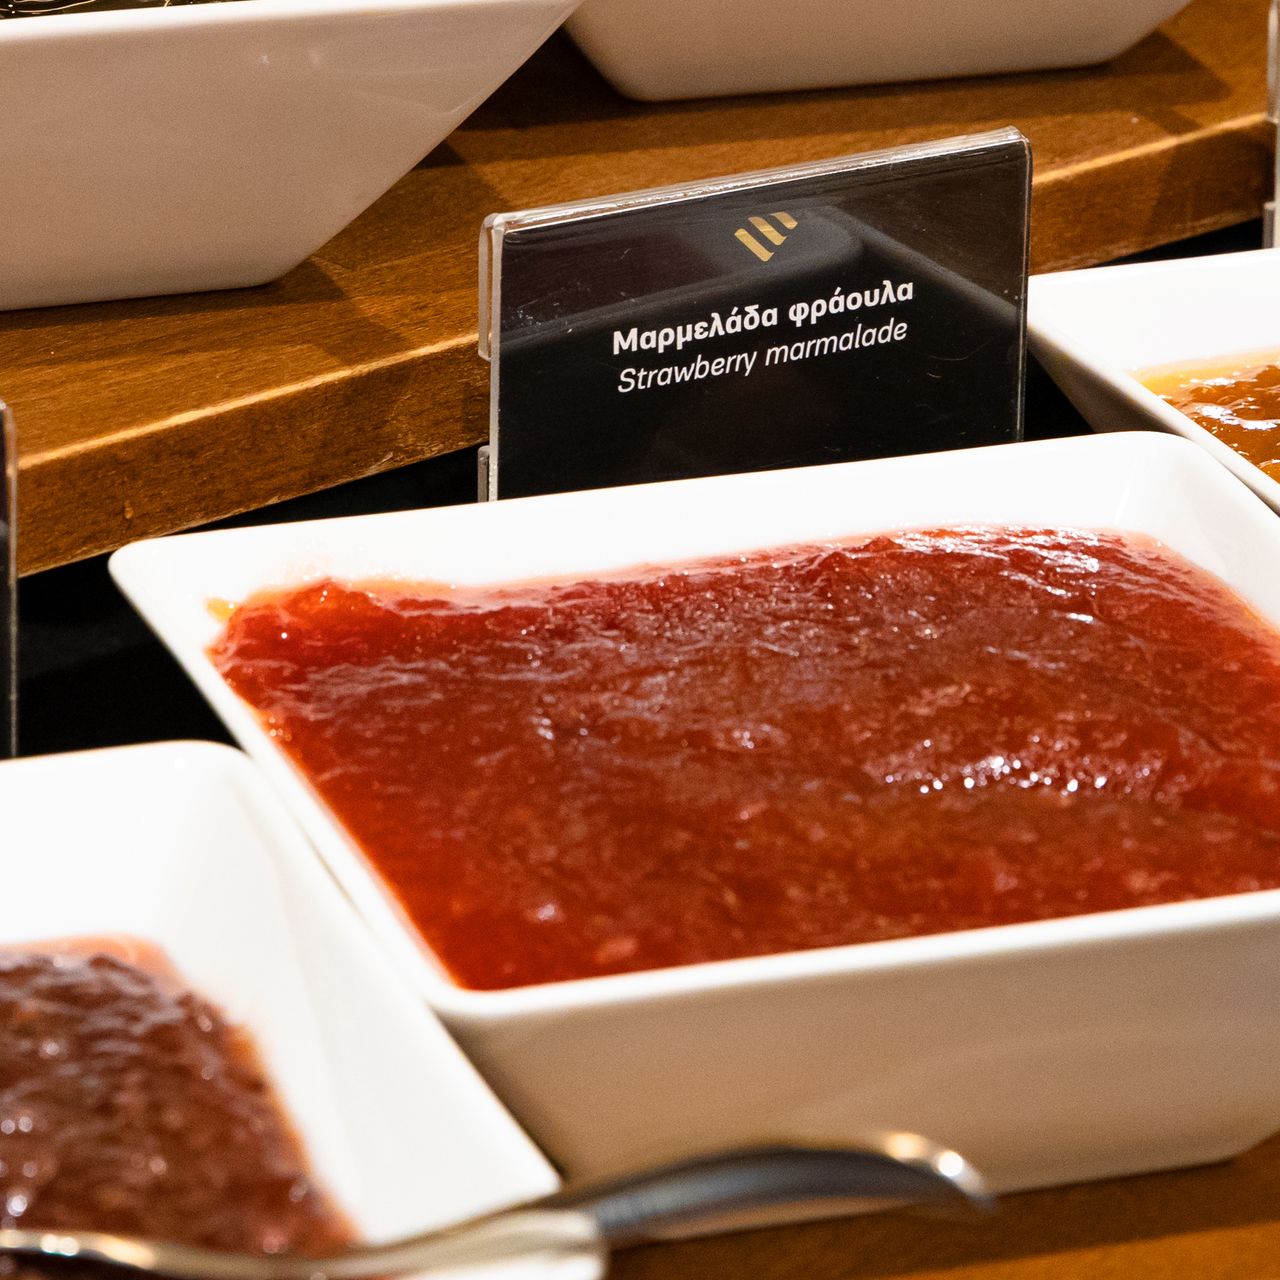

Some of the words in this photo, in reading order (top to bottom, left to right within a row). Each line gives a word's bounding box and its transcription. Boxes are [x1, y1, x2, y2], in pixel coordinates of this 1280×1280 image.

[612, 303, 778, 355] Μαρμελάδα
[787, 279, 914, 326] φράουλα
[617, 348, 758, 393] Strawberry
[764, 317, 908, 368] marmalade
